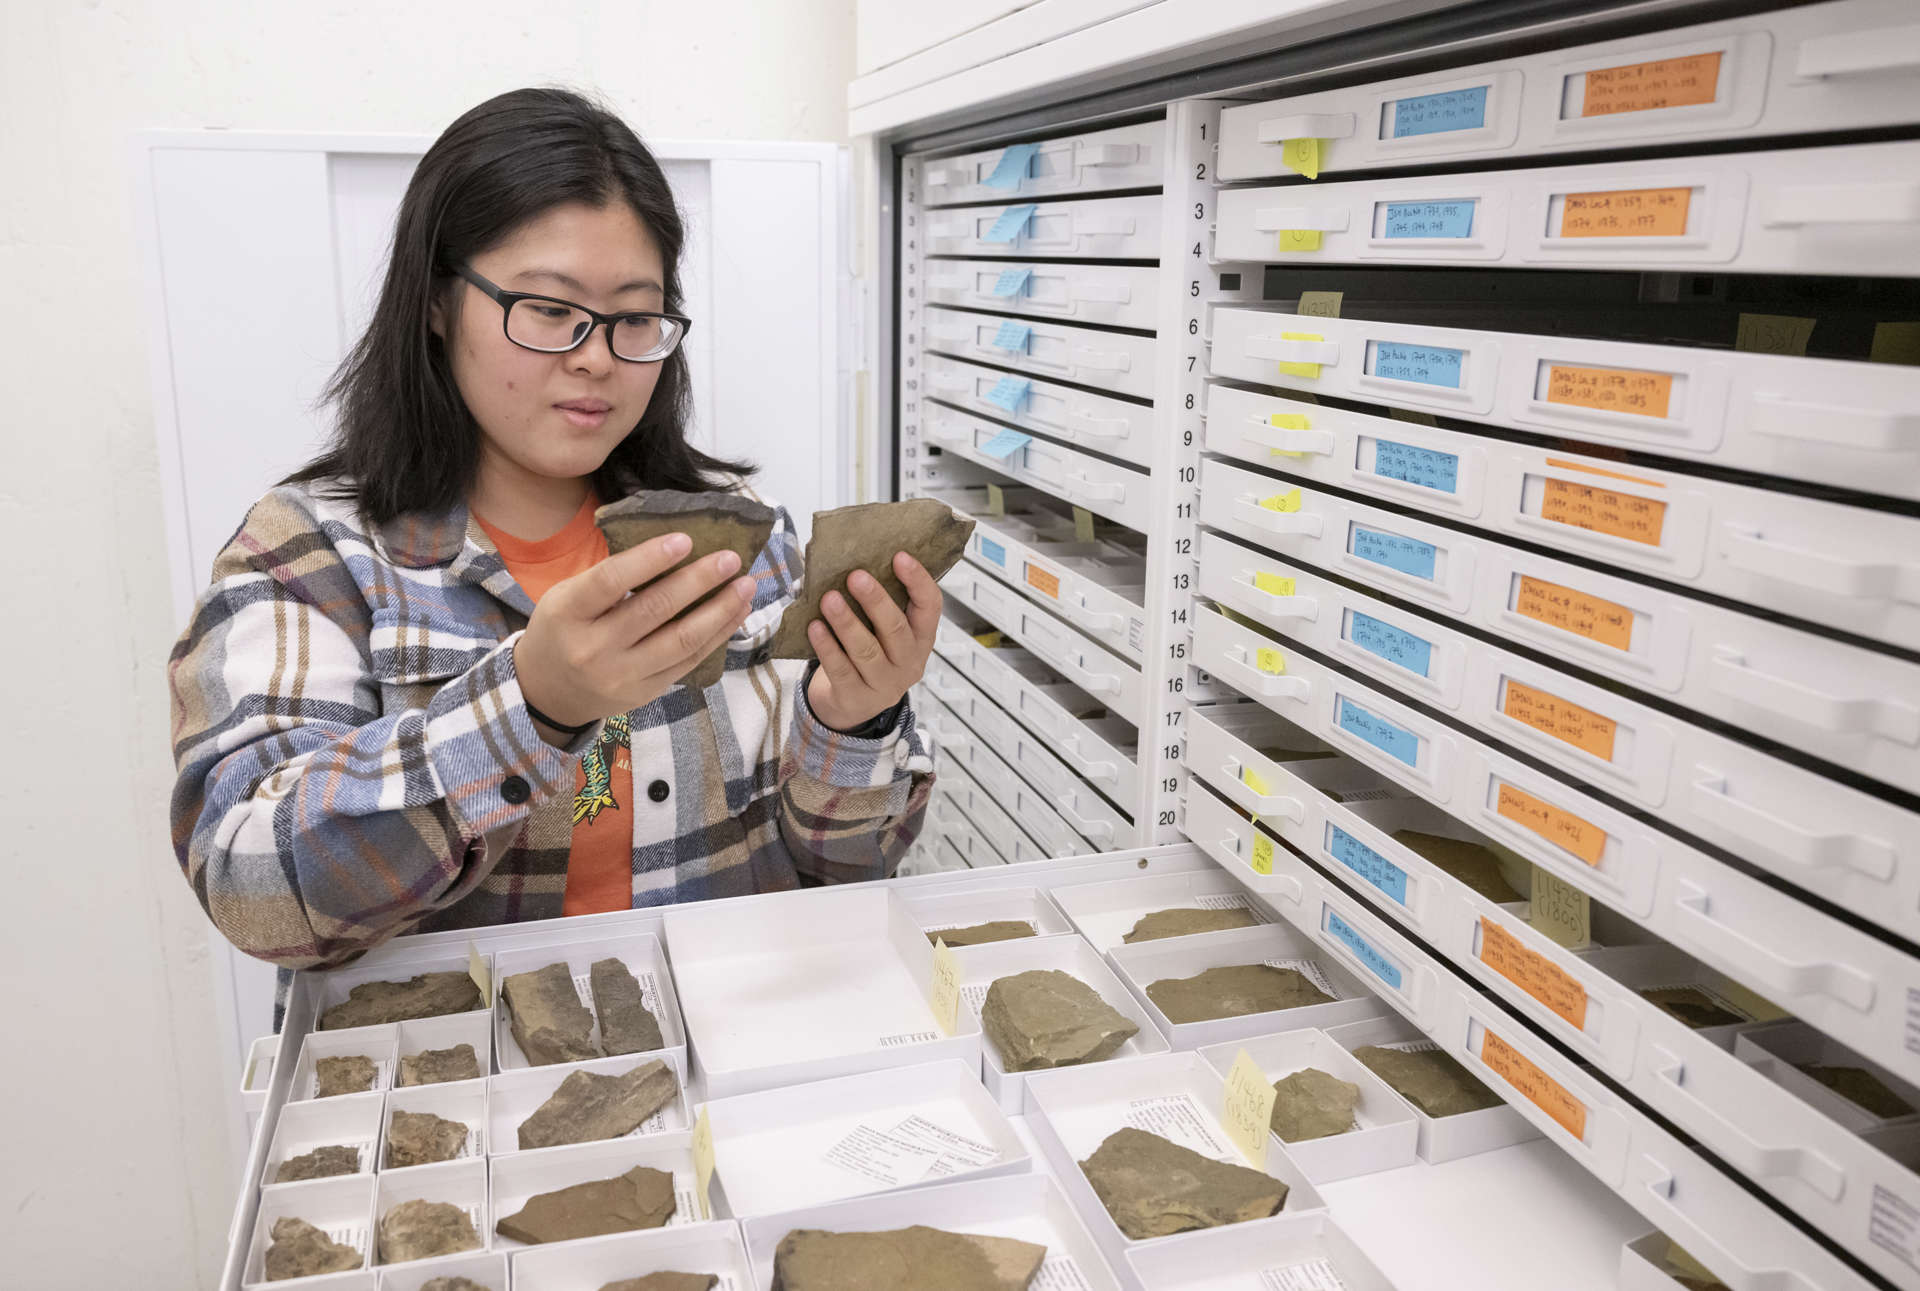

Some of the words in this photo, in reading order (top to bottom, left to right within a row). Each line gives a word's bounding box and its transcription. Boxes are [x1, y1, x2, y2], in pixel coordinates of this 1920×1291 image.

[1200, 123, 1206, 140] 1
[1196, 163, 1206, 180] 2
[1194, 203, 1204, 220] 3
[1193, 242, 1202, 258] 4
[1191, 281, 1200, 297] 5
[1189, 319, 1198, 335] 6
[1188, 356, 1196, 372] 7
[1185, 393, 1194, 409] 8
[1183, 430, 1192, 446] 9
[1179, 467, 1195, 483] 10
[1177, 503, 1191, 518] 11
[1175, 539, 1191, 554] 12
[1173, 574, 1189, 589] 13
[1171, 609, 1186, 624] 14
[1170, 644, 1185, 659] 15
[1168, 677, 1183, 693] 16
[1166, 711, 1181, 726] 17
[1164, 745, 1179, 759] 18
[1162, 778, 1177, 792] 19
[1159, 811, 1175, 825] 20
